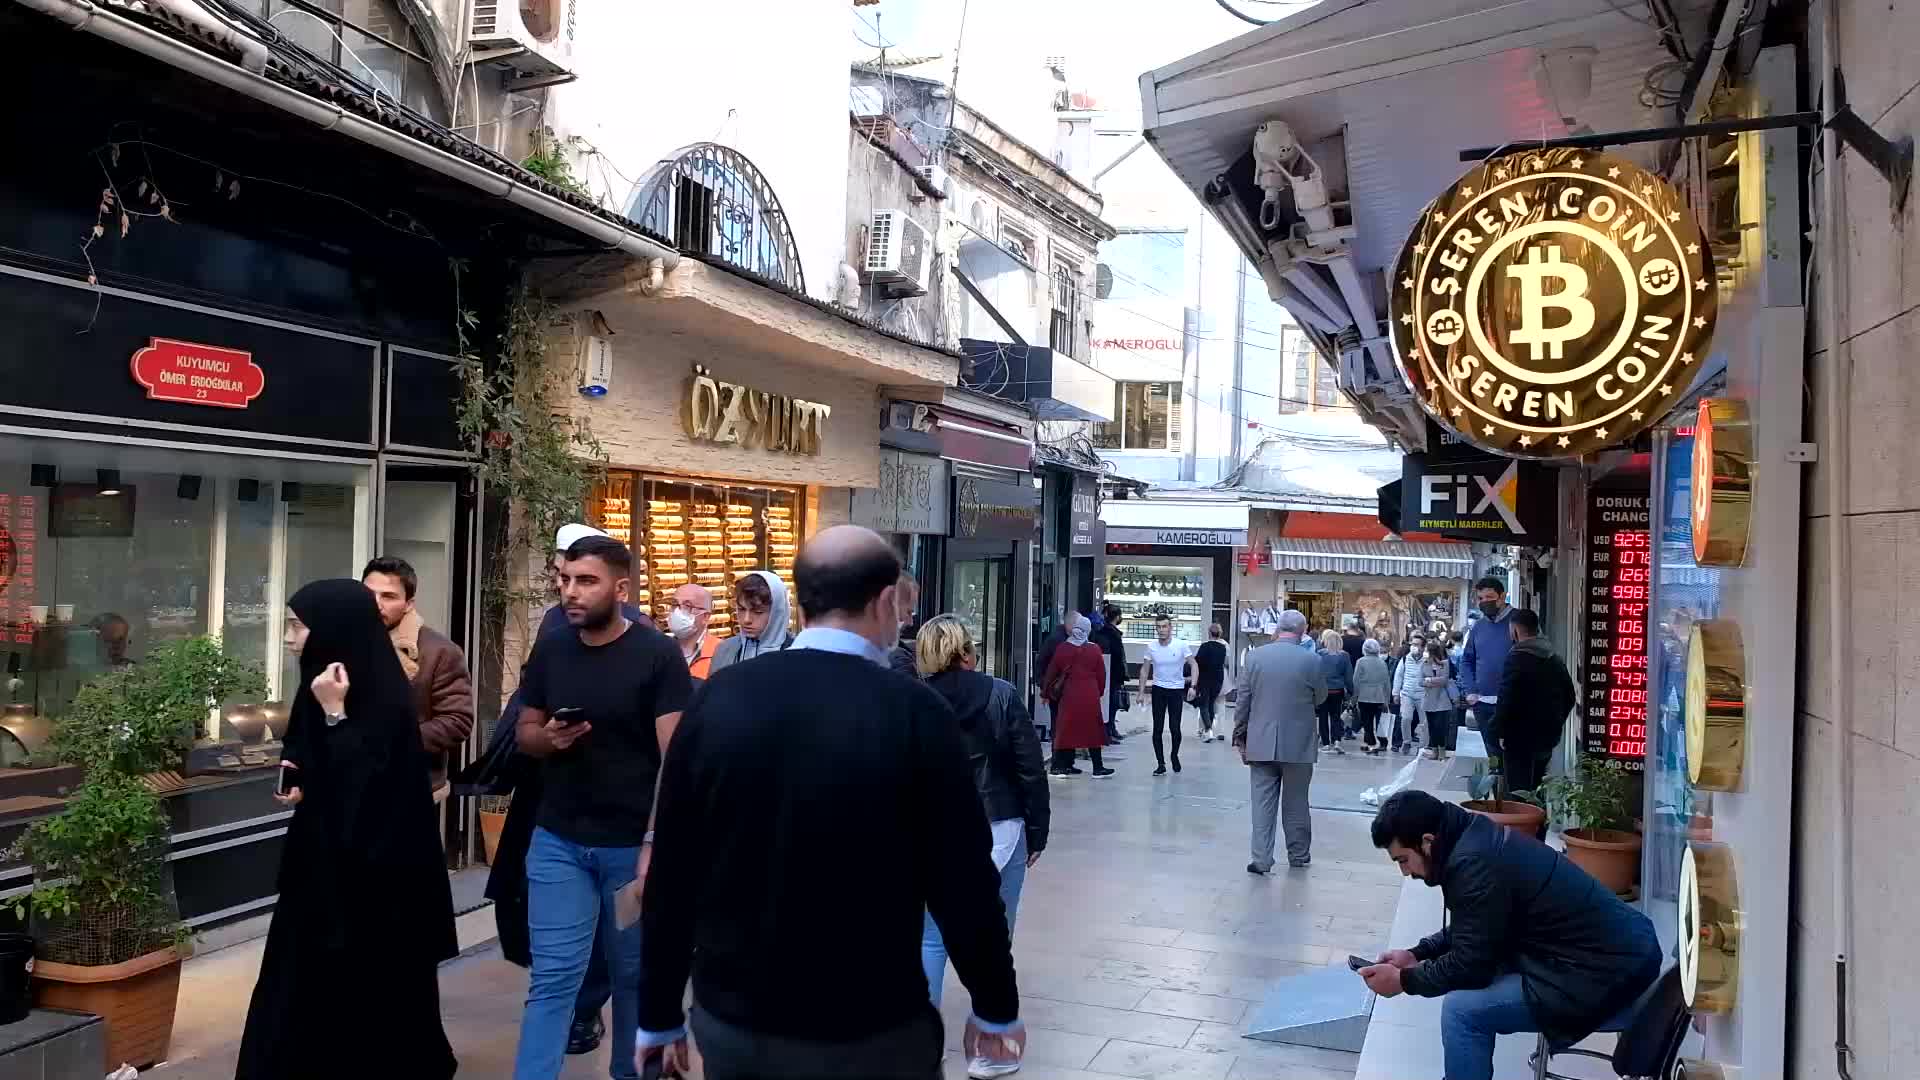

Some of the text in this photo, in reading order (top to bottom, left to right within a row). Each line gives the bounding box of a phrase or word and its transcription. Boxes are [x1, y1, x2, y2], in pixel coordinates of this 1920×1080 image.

[1431, 191, 1529, 297] SEREN
[176, 355, 230, 373] KUYUMCU
[159, 369, 186, 386] ÖMER
[1453, 354, 1574, 418] SEREN
[196, 388, 208, 399] 23
[1596, 497, 1642, 508] DORUK
[1602, 511, 1648, 522] CHANG
[1458, 520, 1503, 529] MADENLER
[1593, 535, 1610, 545] USD
[1593, 552, 1610, 562] EUR
[1592, 569, 1609, 579] GBP
[1592, 586, 1609, 596] CHF
[1591, 603, 1609, 614] DKK
[1591, 620, 1608, 631] SEK
[1591, 638, 1608, 648] NOK
[1590, 655, 1607, 665] AUD
[1590, 672, 1607, 682] CAD
[1589, 689, 1605, 700] JPY
[1589, 707, 1606, 717] SAR
[1589, 724, 1606, 734] RUB
